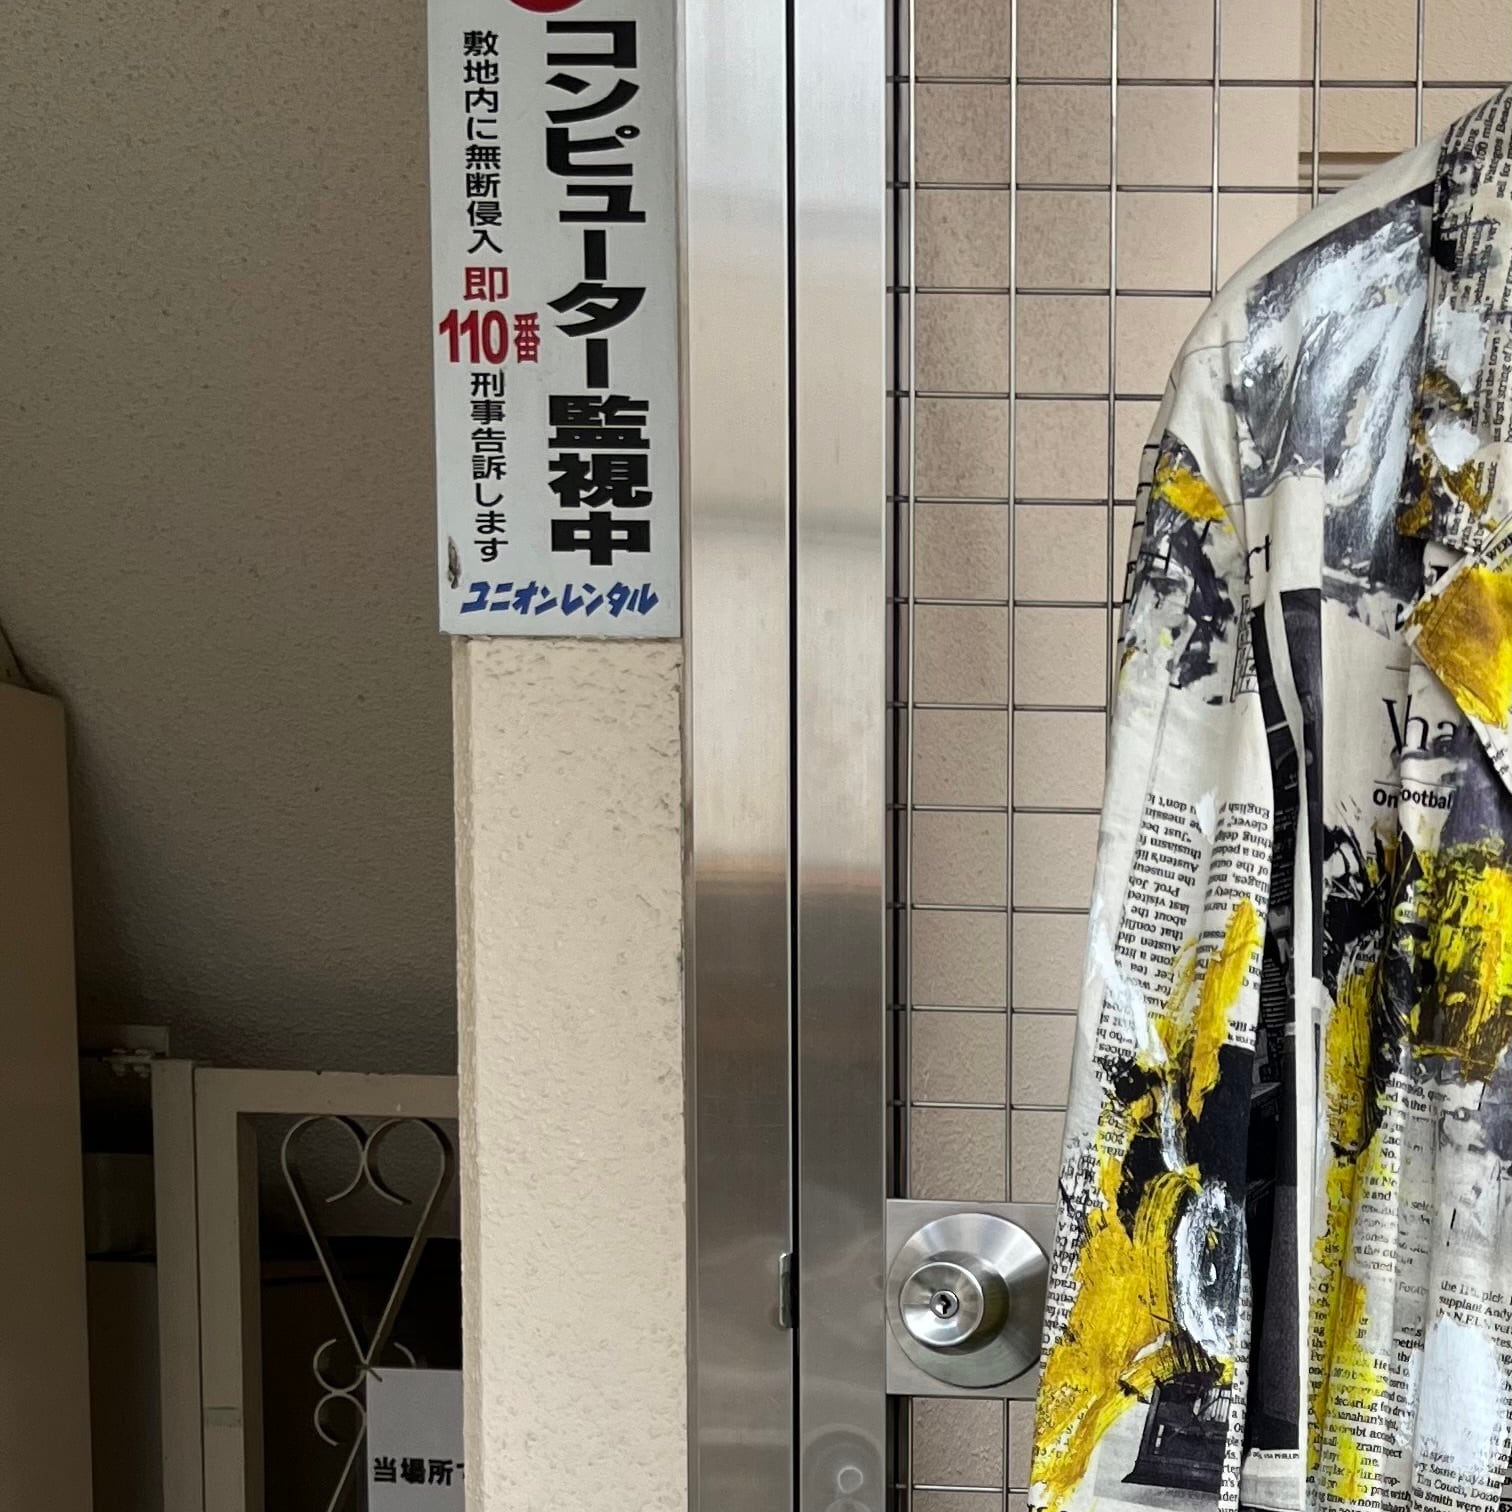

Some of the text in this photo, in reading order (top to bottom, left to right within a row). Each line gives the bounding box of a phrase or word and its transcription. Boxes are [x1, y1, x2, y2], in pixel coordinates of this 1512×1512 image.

[439, 30, 541, 563] 敷地内に無断侵入 即 110番 刑事告訴します
[545, 21, 653, 566] コンピューター監視中
[460, 581, 659, 617] ユニオンレンタル
